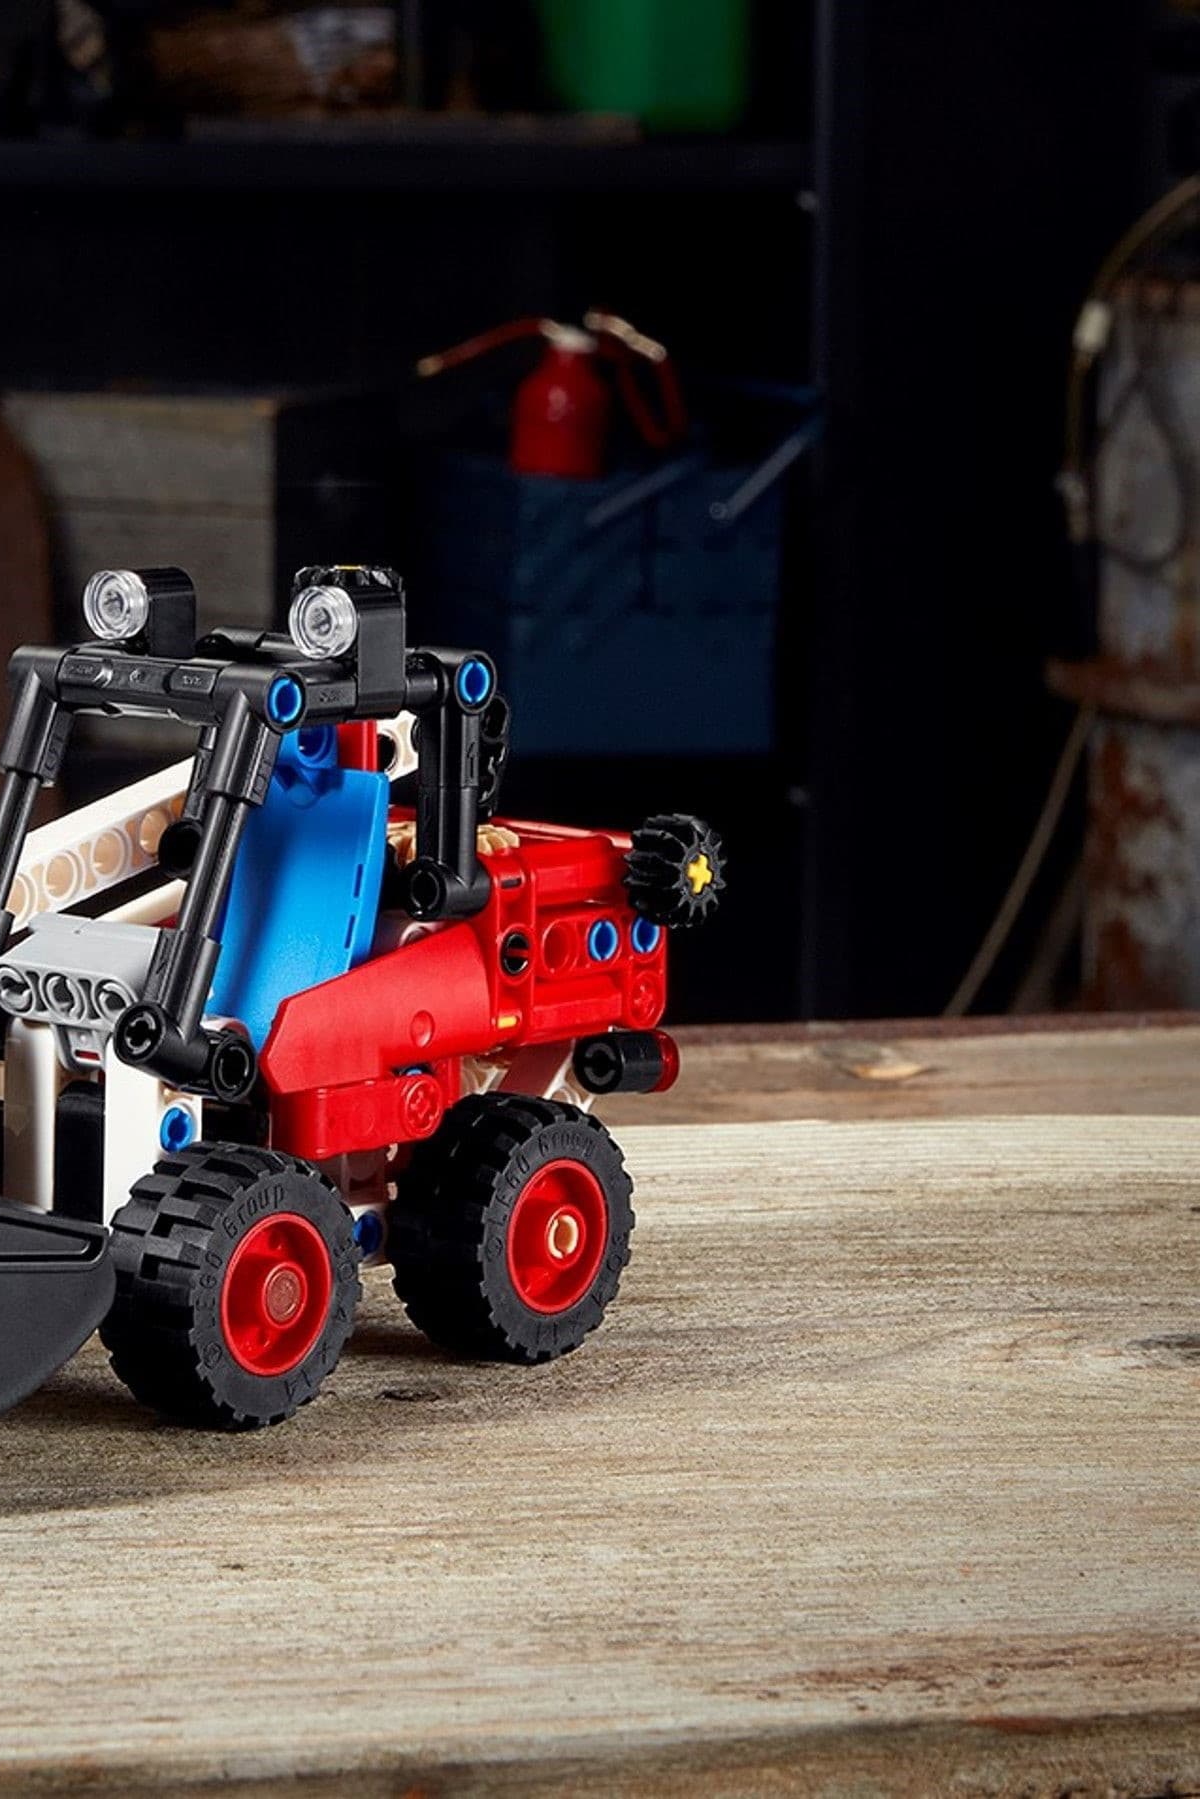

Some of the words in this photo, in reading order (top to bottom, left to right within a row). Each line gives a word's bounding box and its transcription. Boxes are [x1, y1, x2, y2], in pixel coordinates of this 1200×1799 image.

[222, 1183, 285, 1239] Group
[489, 1154, 531, 1227] LEGO
[538, 1131, 595, 1158] Group
